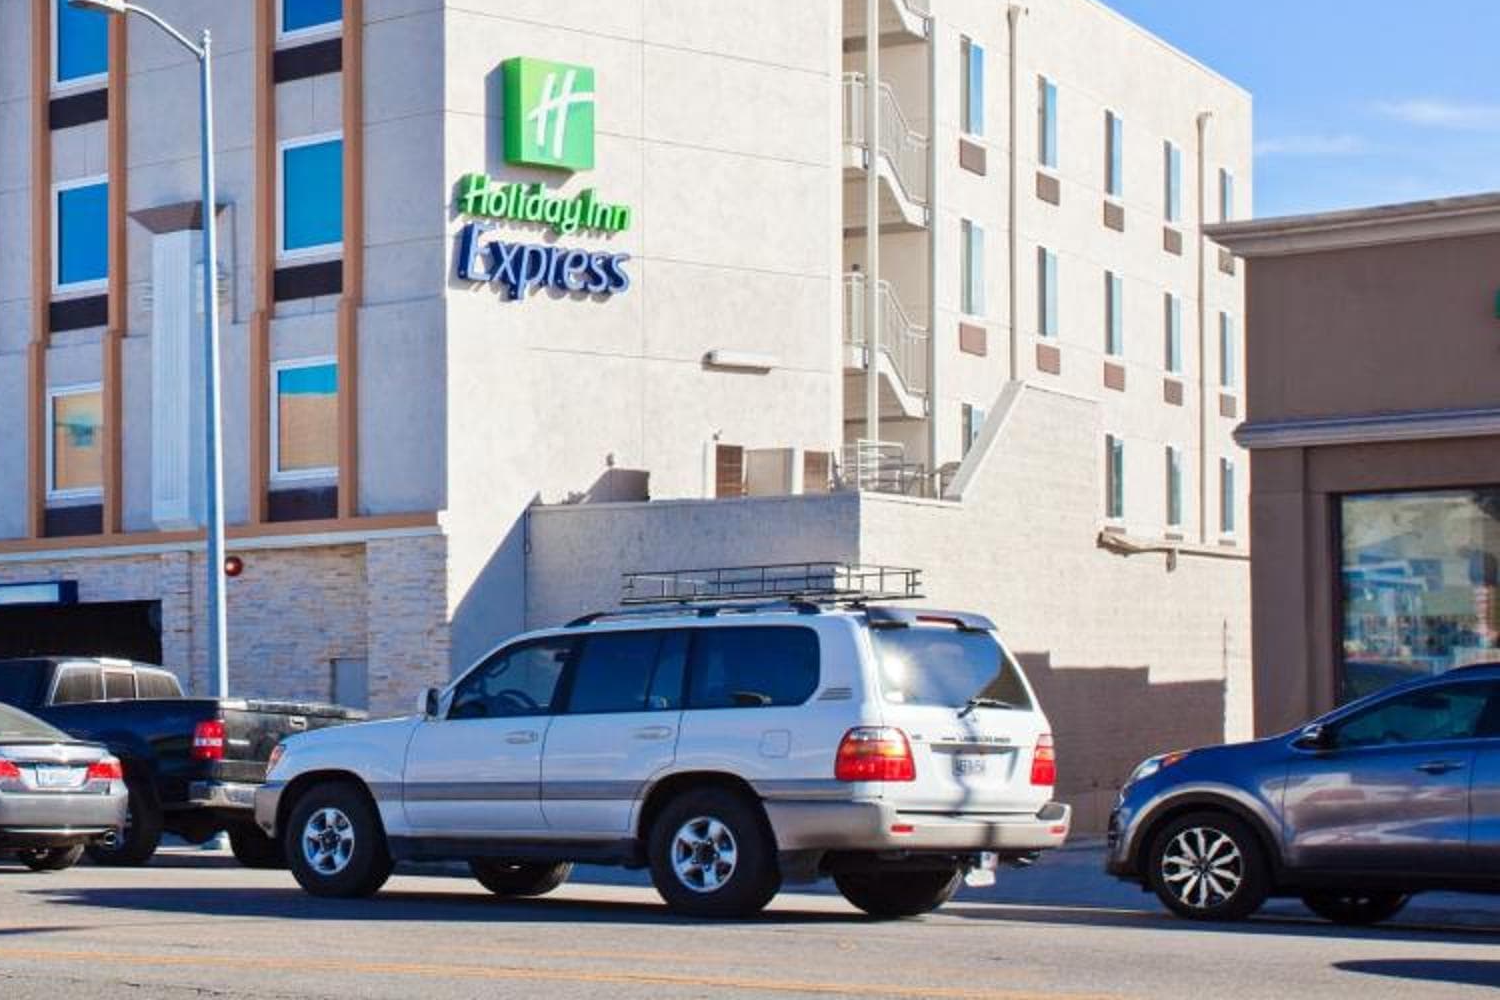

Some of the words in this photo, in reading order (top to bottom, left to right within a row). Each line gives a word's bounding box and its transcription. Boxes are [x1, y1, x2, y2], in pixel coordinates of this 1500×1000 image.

[462, 172, 583, 236] Holiday
[583, 187, 634, 233] Inn
[458, 220, 631, 304] Express
